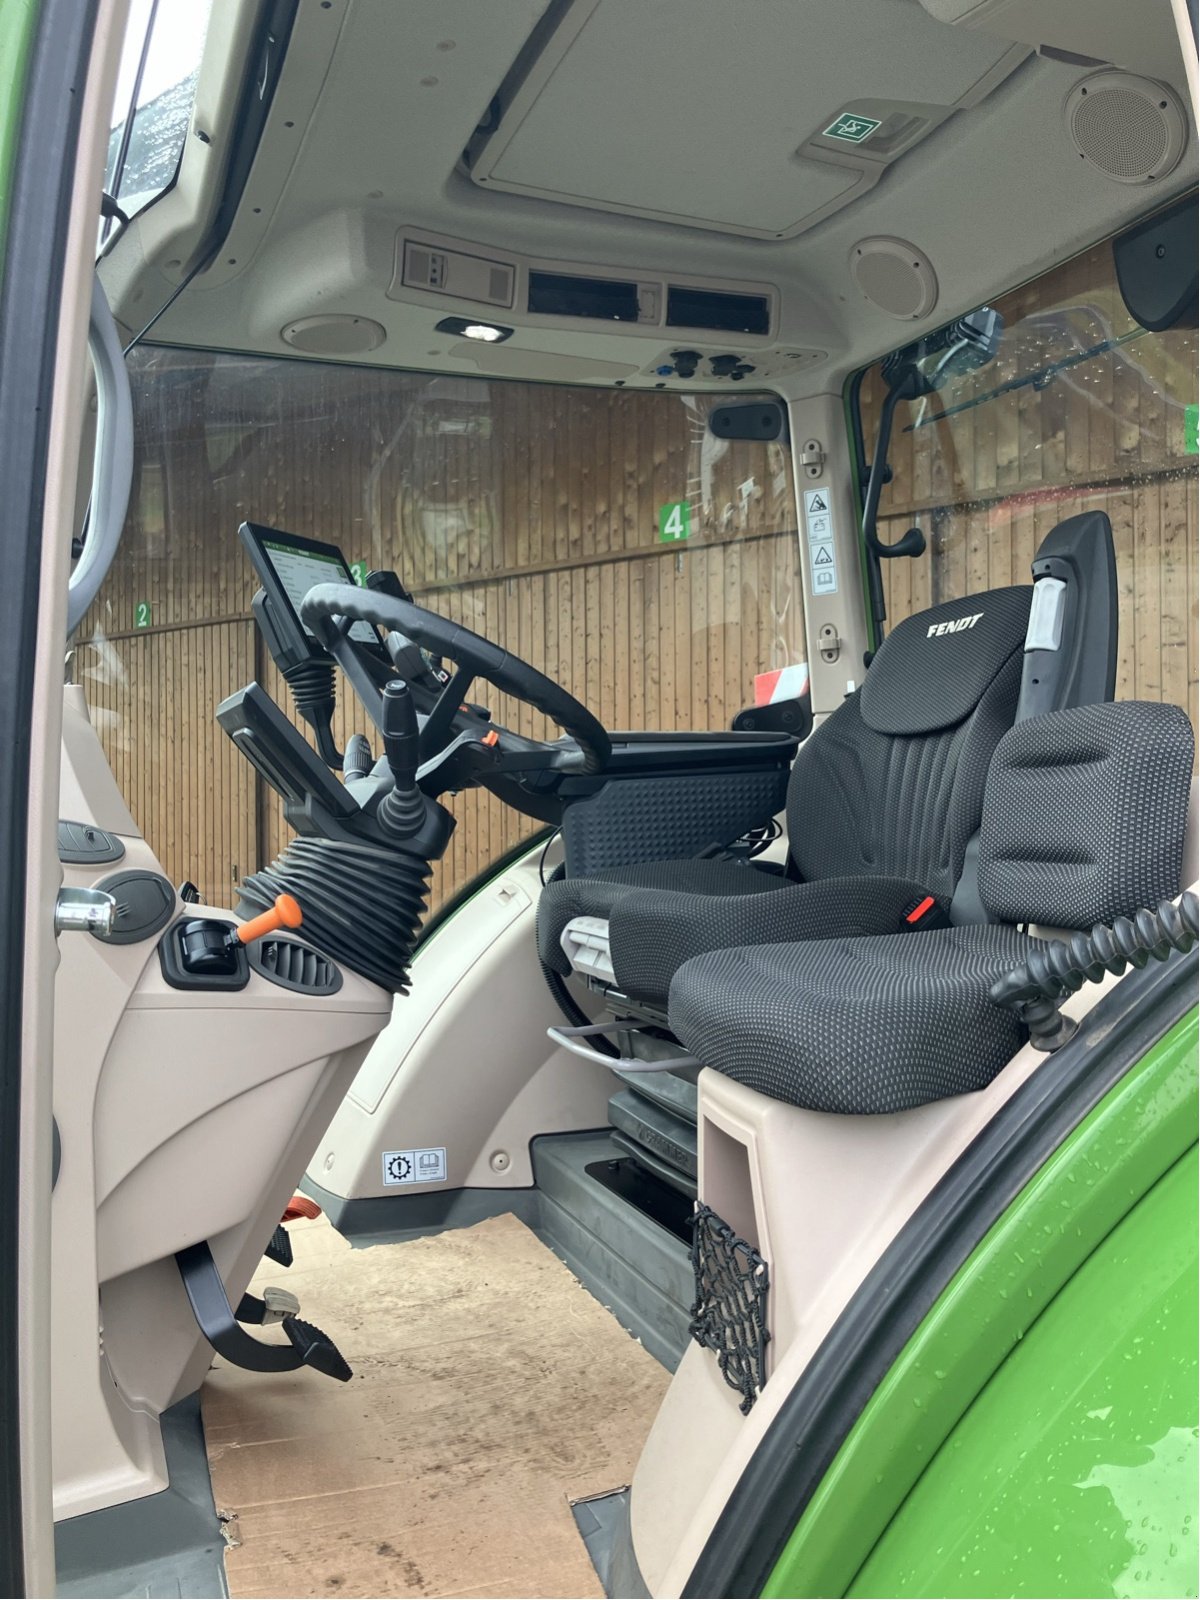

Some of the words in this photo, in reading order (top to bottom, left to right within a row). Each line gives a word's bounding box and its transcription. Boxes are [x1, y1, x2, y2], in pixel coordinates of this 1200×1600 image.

[664, 504, 684, 539] 4
[351, 564, 362, 587] 3
[138, 603, 147, 627] 2
[926, 612, 985, 638] FENDT
